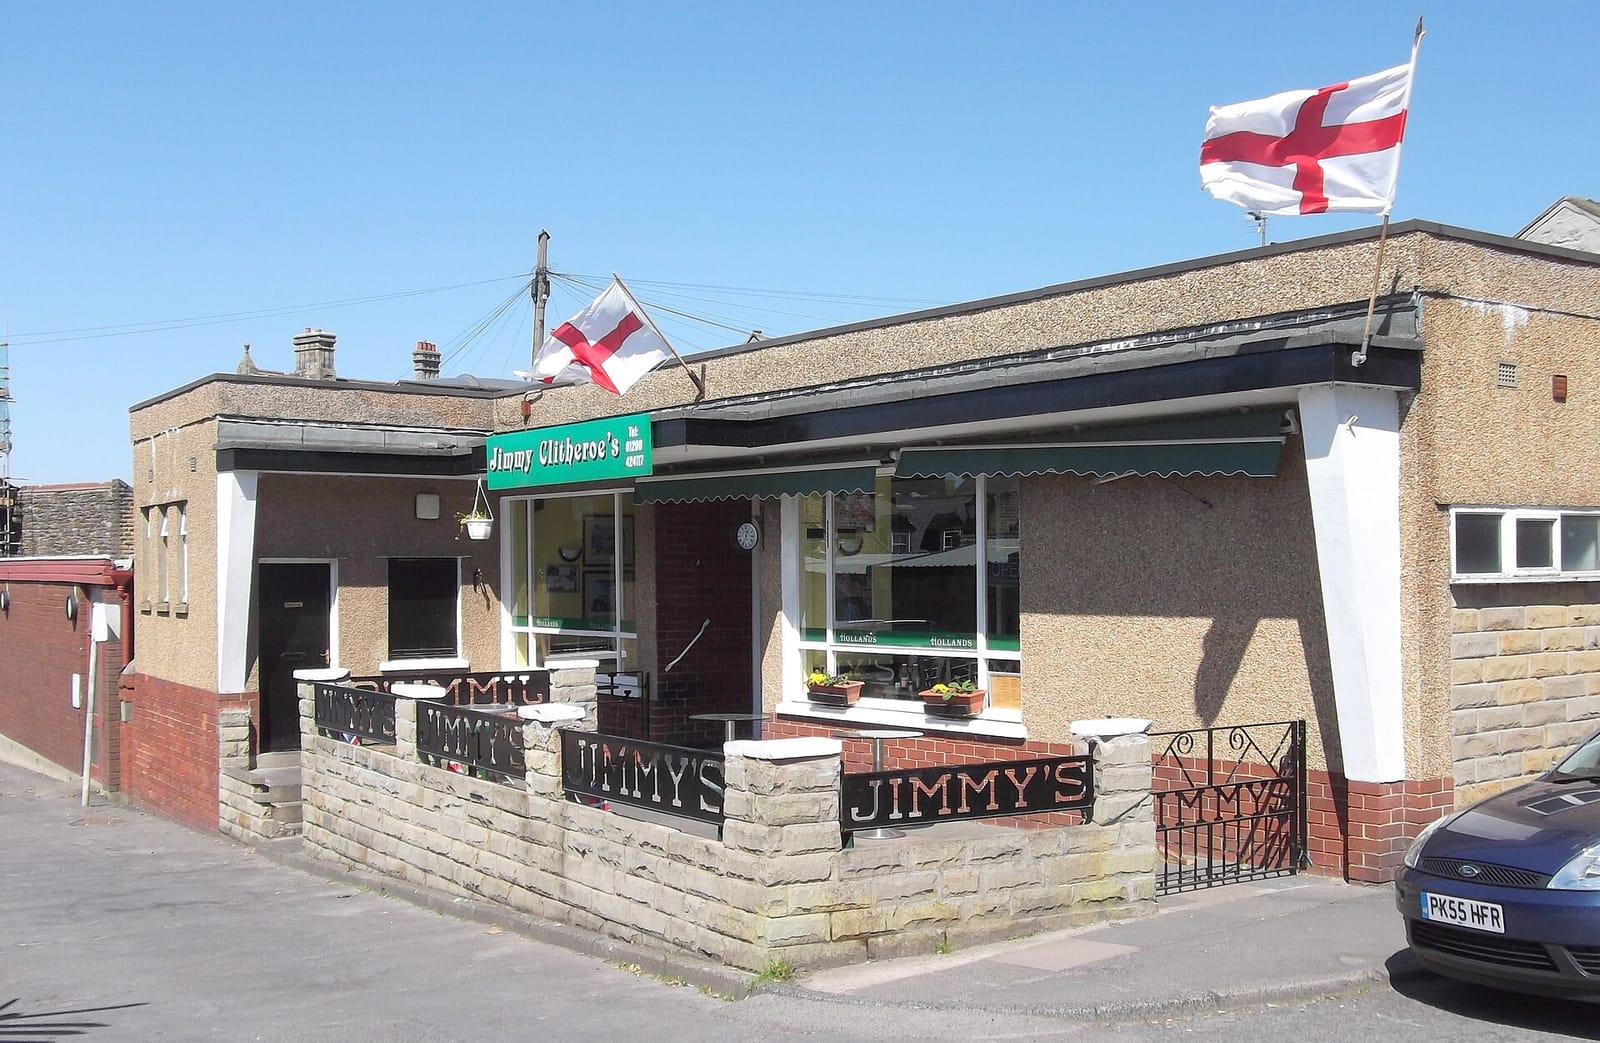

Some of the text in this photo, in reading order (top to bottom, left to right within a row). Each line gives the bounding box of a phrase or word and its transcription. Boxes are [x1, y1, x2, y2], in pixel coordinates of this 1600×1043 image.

[490, 431, 620, 472] Jimmy Clitheroe's
[566, 739, 724, 814] JIMMY'S
[850, 760, 1087, 822] JIMMY'S
[1430, 896, 1501, 928] PK55 HFR
